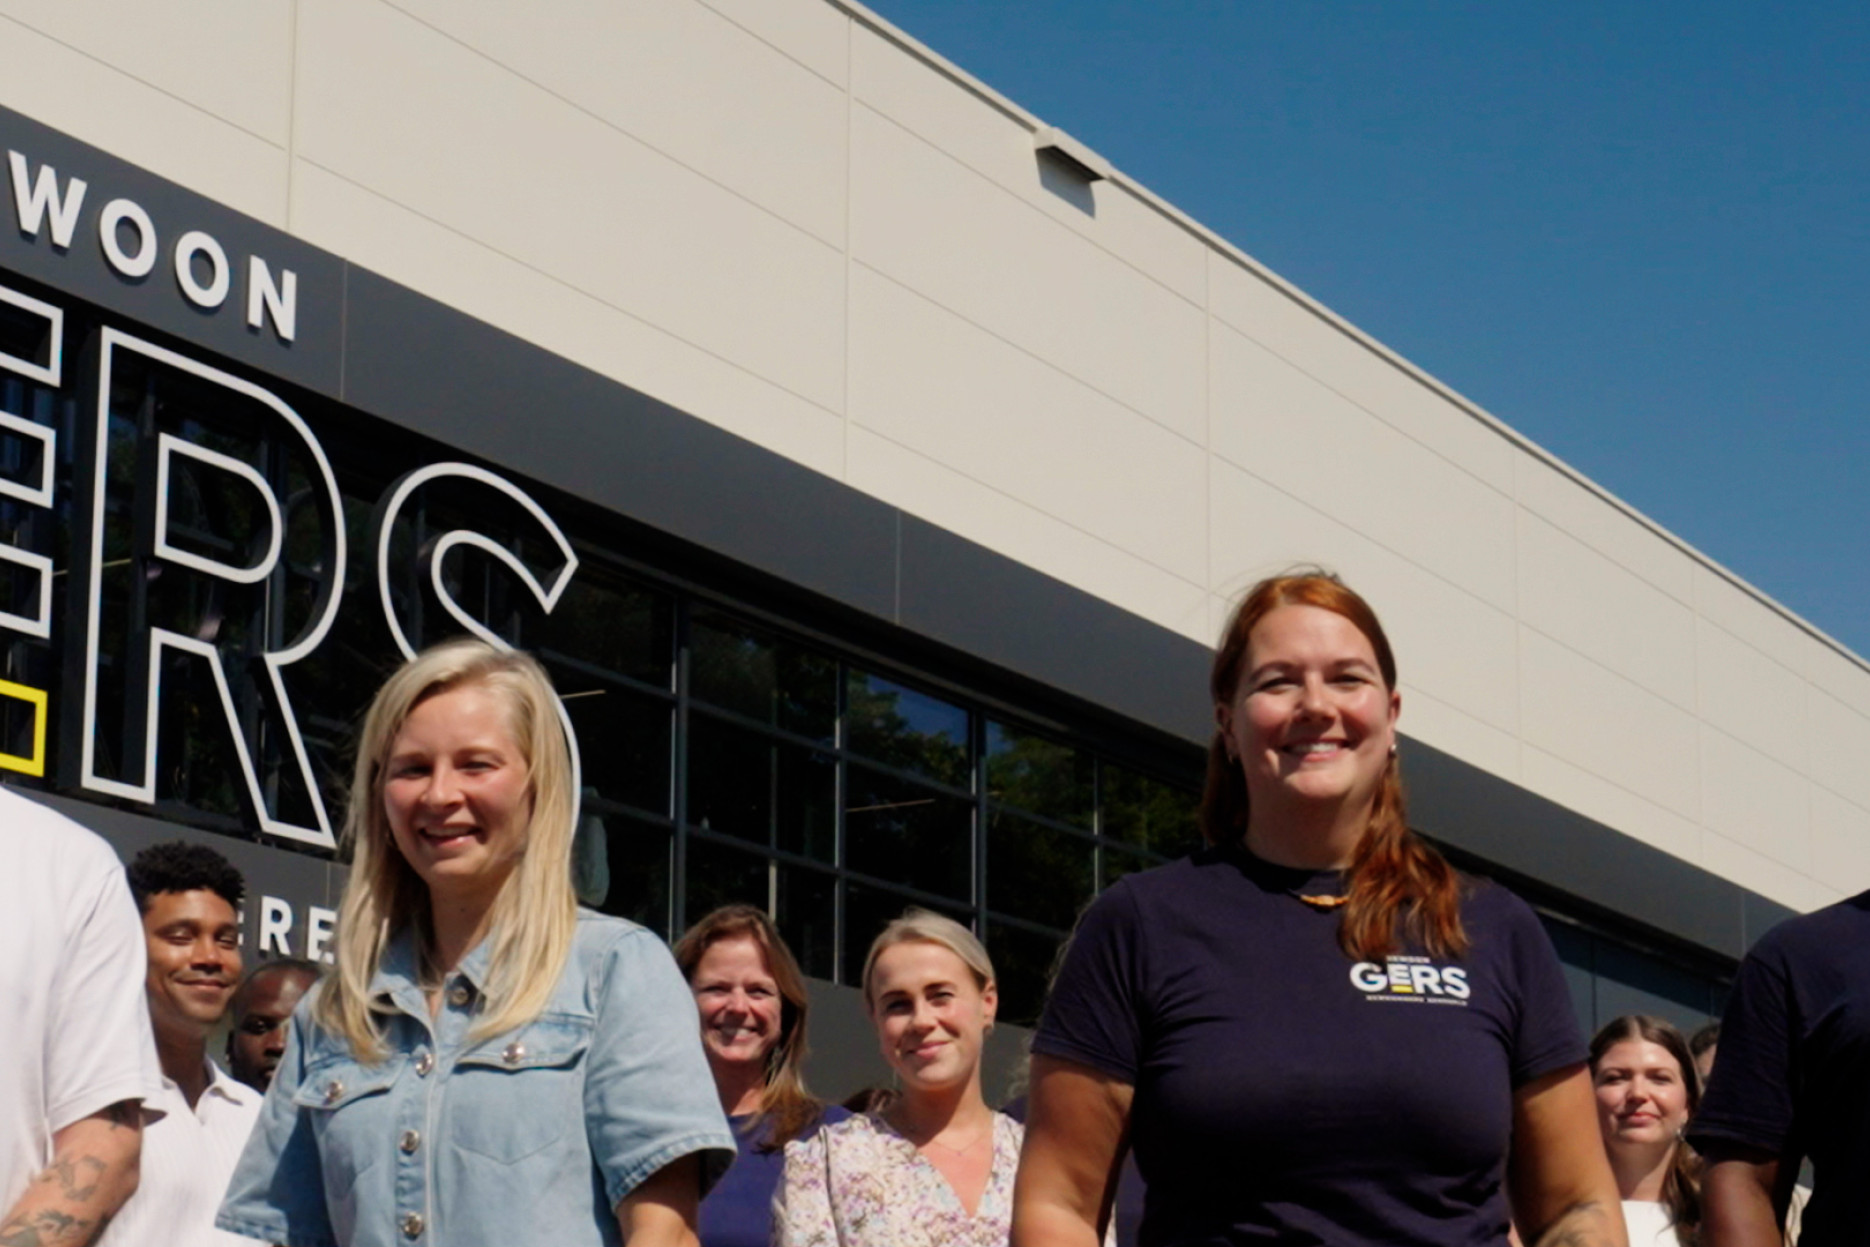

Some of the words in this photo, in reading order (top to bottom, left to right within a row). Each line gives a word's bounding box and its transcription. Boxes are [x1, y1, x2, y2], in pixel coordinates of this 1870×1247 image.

[8, 150, 297, 342] WOON
[238, 894, 338, 965] RE
[1350, 962, 1471, 999] GERS
